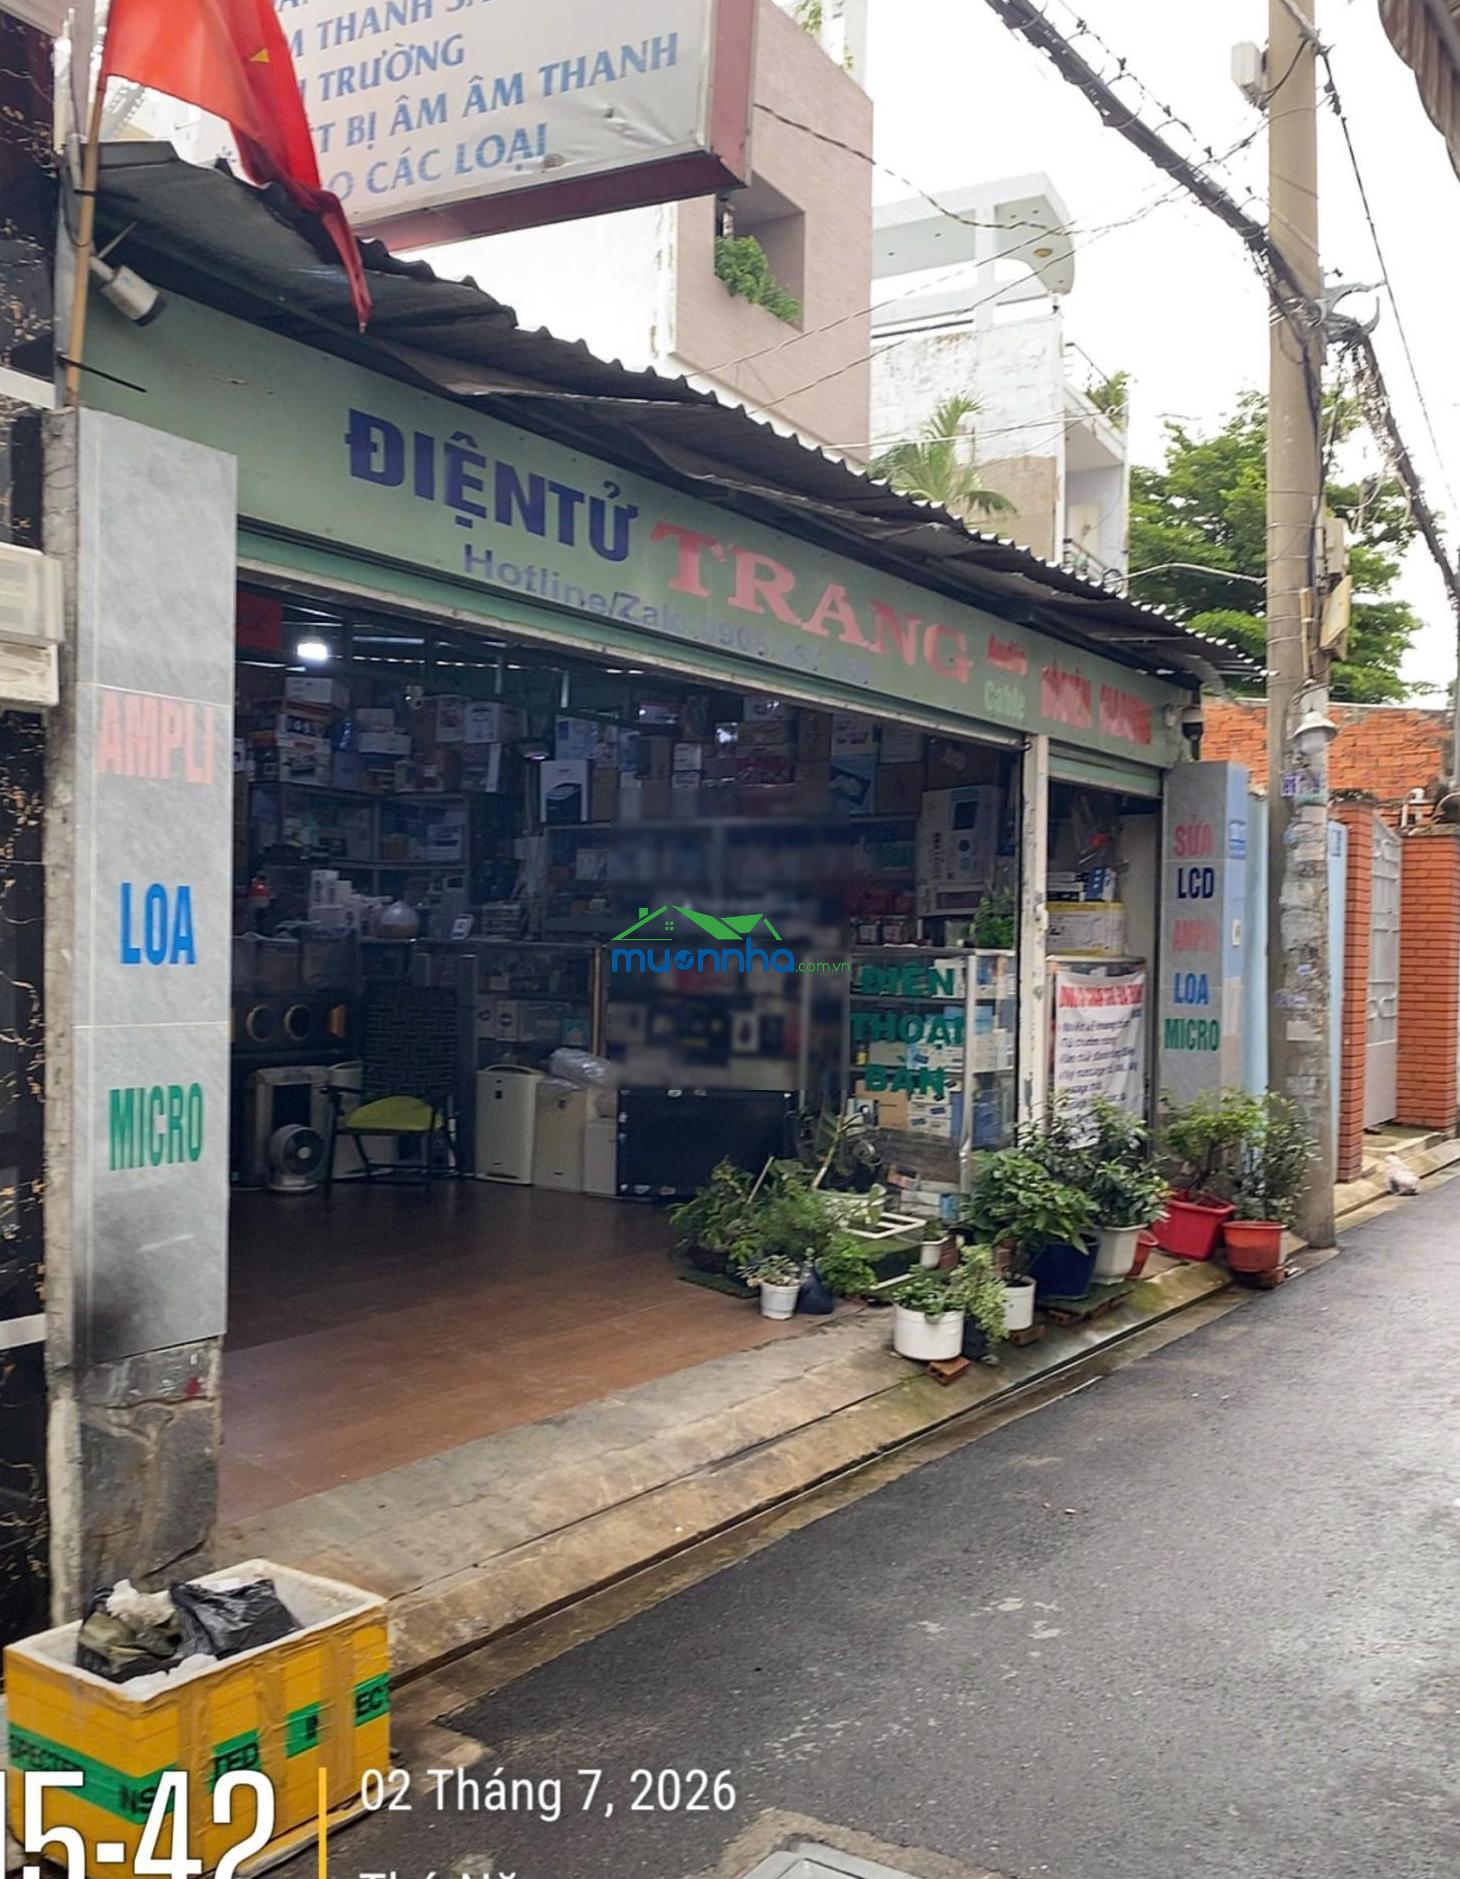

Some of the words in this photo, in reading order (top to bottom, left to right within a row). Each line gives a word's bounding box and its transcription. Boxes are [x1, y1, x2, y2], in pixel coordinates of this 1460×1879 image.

[316, 0, 434, 51] THANH
[318, 33, 465, 102] TRƯỜNG
[346, 111, 377, 150] BỊ
[389, 94, 448, 137] ÂM
[462, 73, 525, 118] ÂM
[538, 31, 679, 98] THANH
[366, 146, 442, 194] CÁC
[455, 122, 549, 173] LOẠI
[650, 519, 973, 686] TRANG
[95, 690, 215, 785] AMPLI
[1176, 866, 1215, 899] LCD
[120, 882, 197, 966] LOA
[1173, 971, 1210, 1006] LOA
[1164, 1018, 1221, 1051] MICRO
[109, 1082, 203, 1171] MICRO
